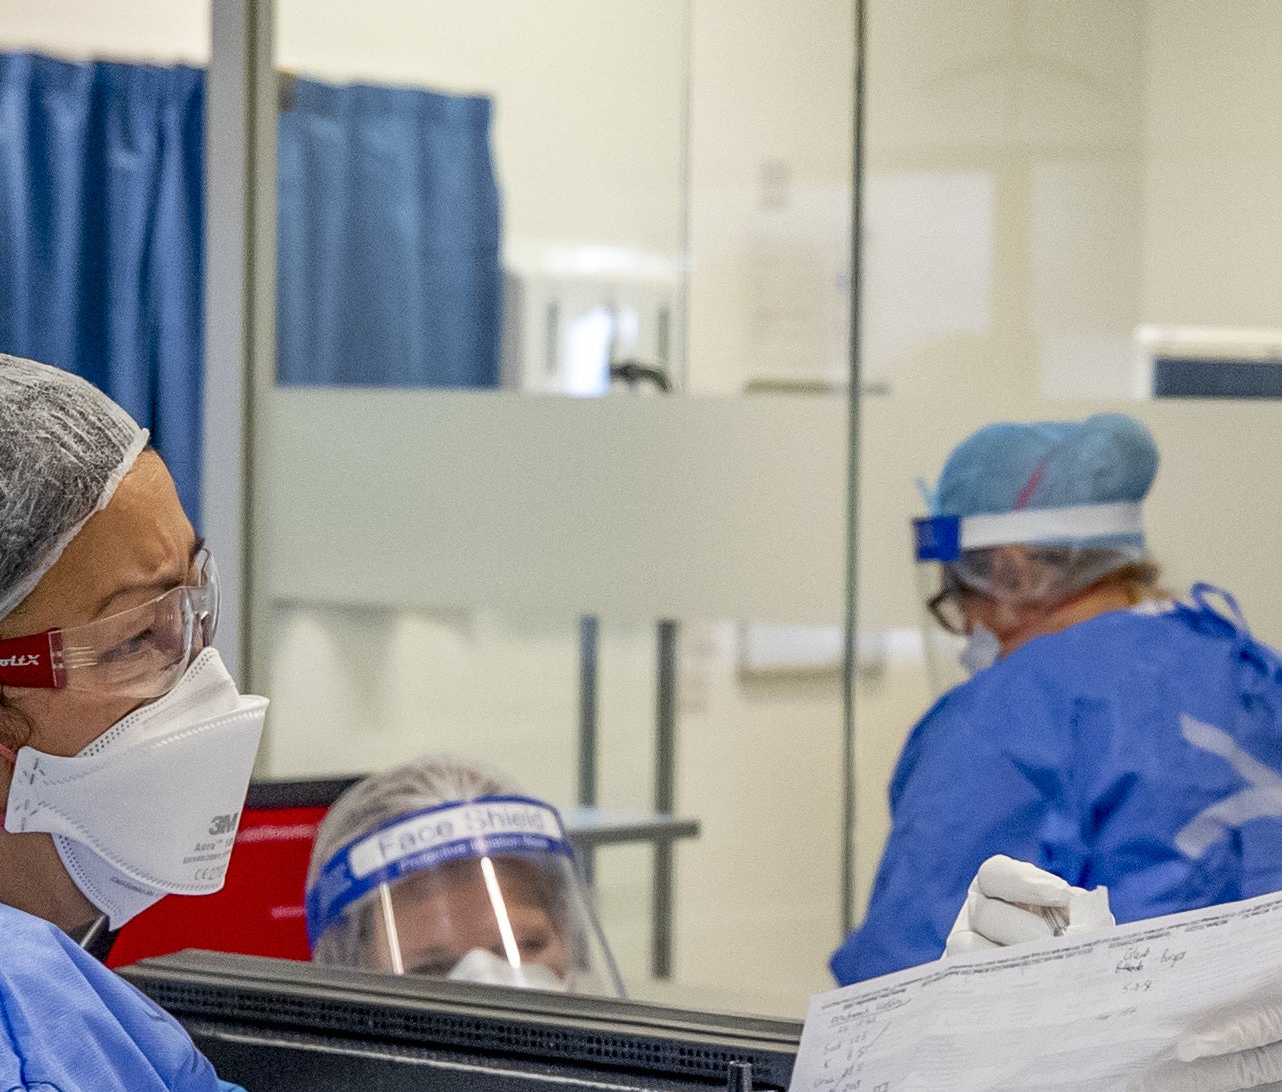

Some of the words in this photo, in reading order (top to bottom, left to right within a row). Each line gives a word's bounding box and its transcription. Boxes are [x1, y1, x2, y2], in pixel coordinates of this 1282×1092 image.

[208, 812, 239, 836] 3M
[378, 819, 454, 860] Face
[464, 805, 545, 834] Shield
